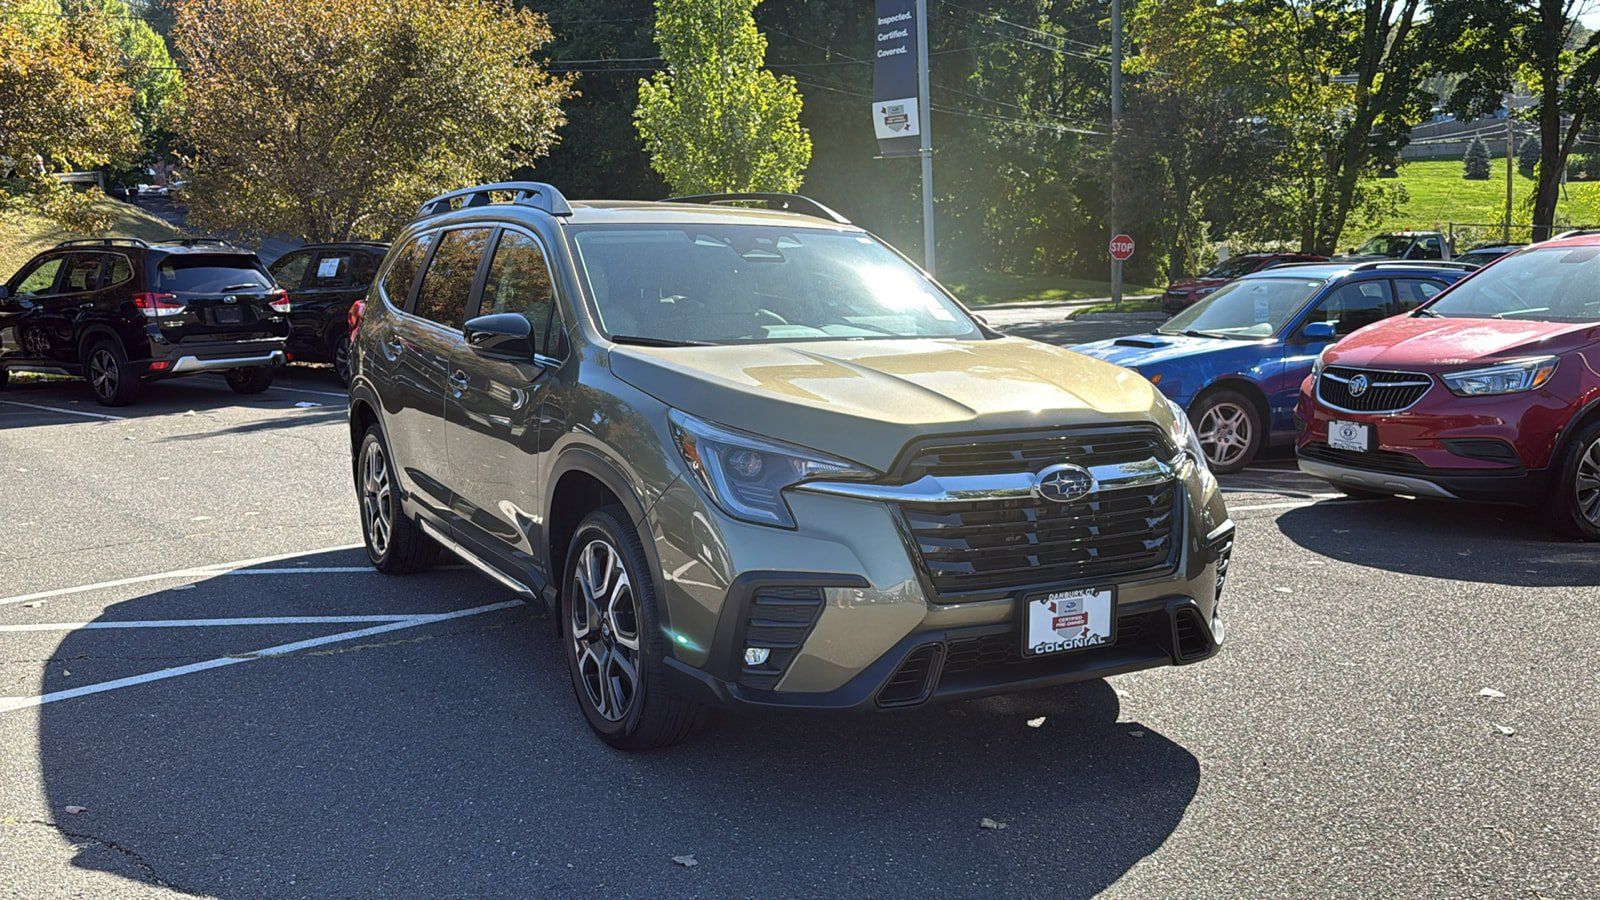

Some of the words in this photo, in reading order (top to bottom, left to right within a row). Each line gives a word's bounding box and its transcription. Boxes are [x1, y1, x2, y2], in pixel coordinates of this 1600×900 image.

[878, 11, 912, 25] Inspected.
[877, 28, 908, 41] Certified.
[877, 45, 907, 57] Covered.
[1111, 242, 1133, 252] STOP
[1048, 589, 1083, 600] DANBURY
[1035, 637, 1105, 654] COLONIAL
